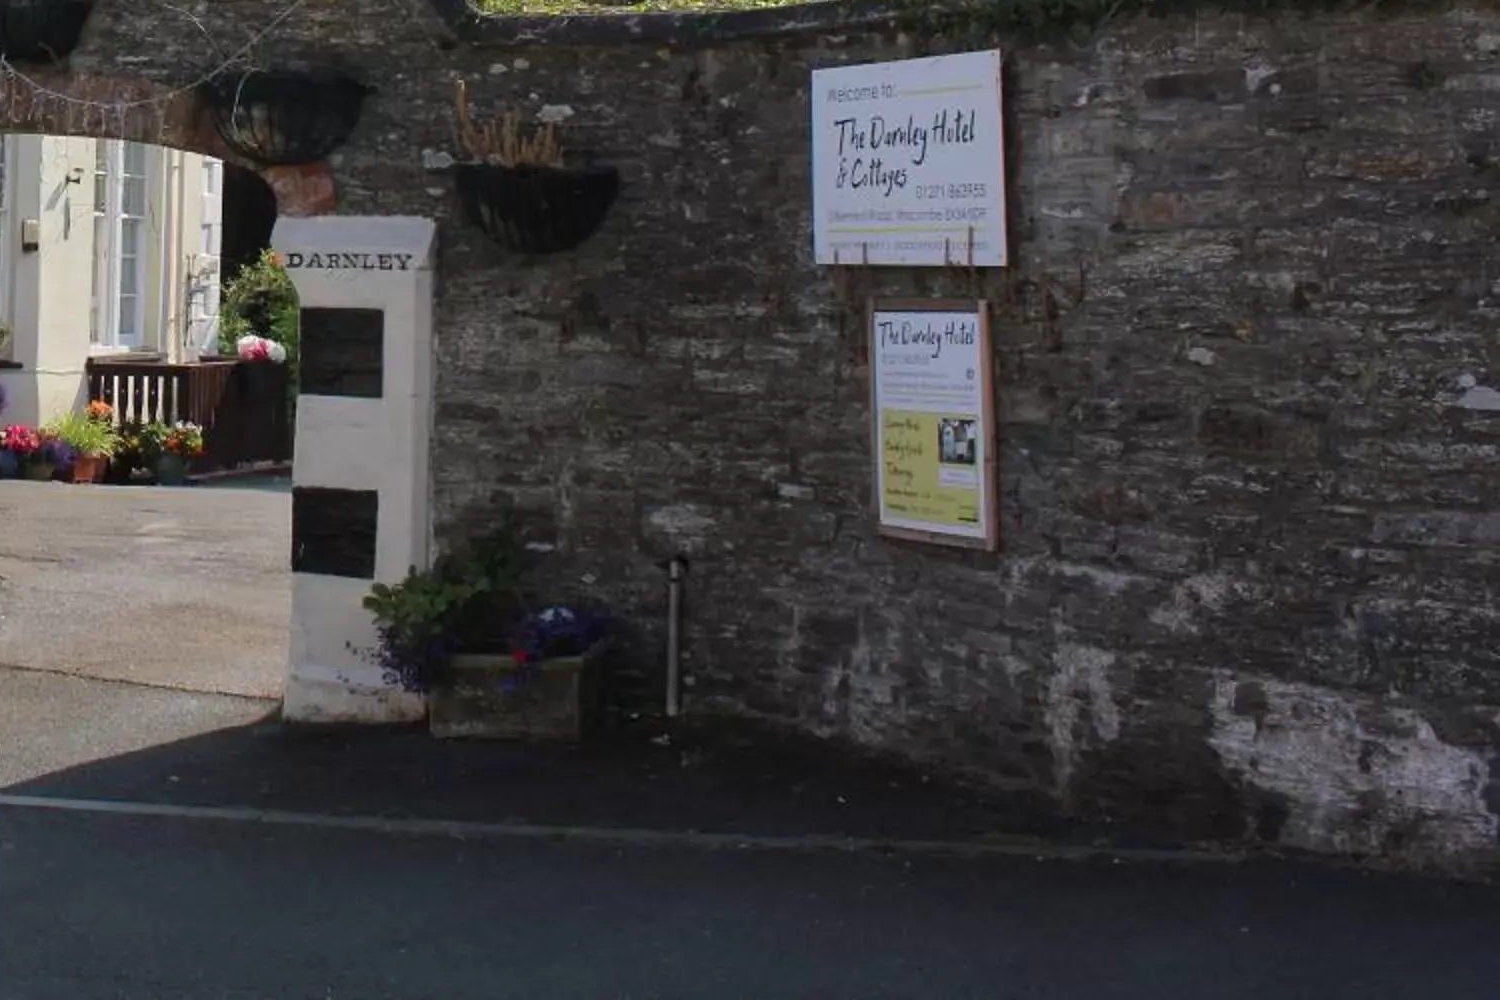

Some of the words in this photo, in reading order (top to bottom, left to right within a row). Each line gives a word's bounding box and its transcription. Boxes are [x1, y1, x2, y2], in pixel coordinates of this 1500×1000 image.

[827, 86, 879, 103] Welcome
[834, 117, 865, 156] The
[870, 113, 928, 165] Darnley
[932, 108, 975, 144] Hotel
[836, 158, 849, 189] &
[851, 158, 908, 197] Cottages
[285, 252, 413, 271] DARNLEY
[878, 321, 899, 348] The
[901, 321, 942, 358] Darnley
[945, 321, 975, 346] Hotel
